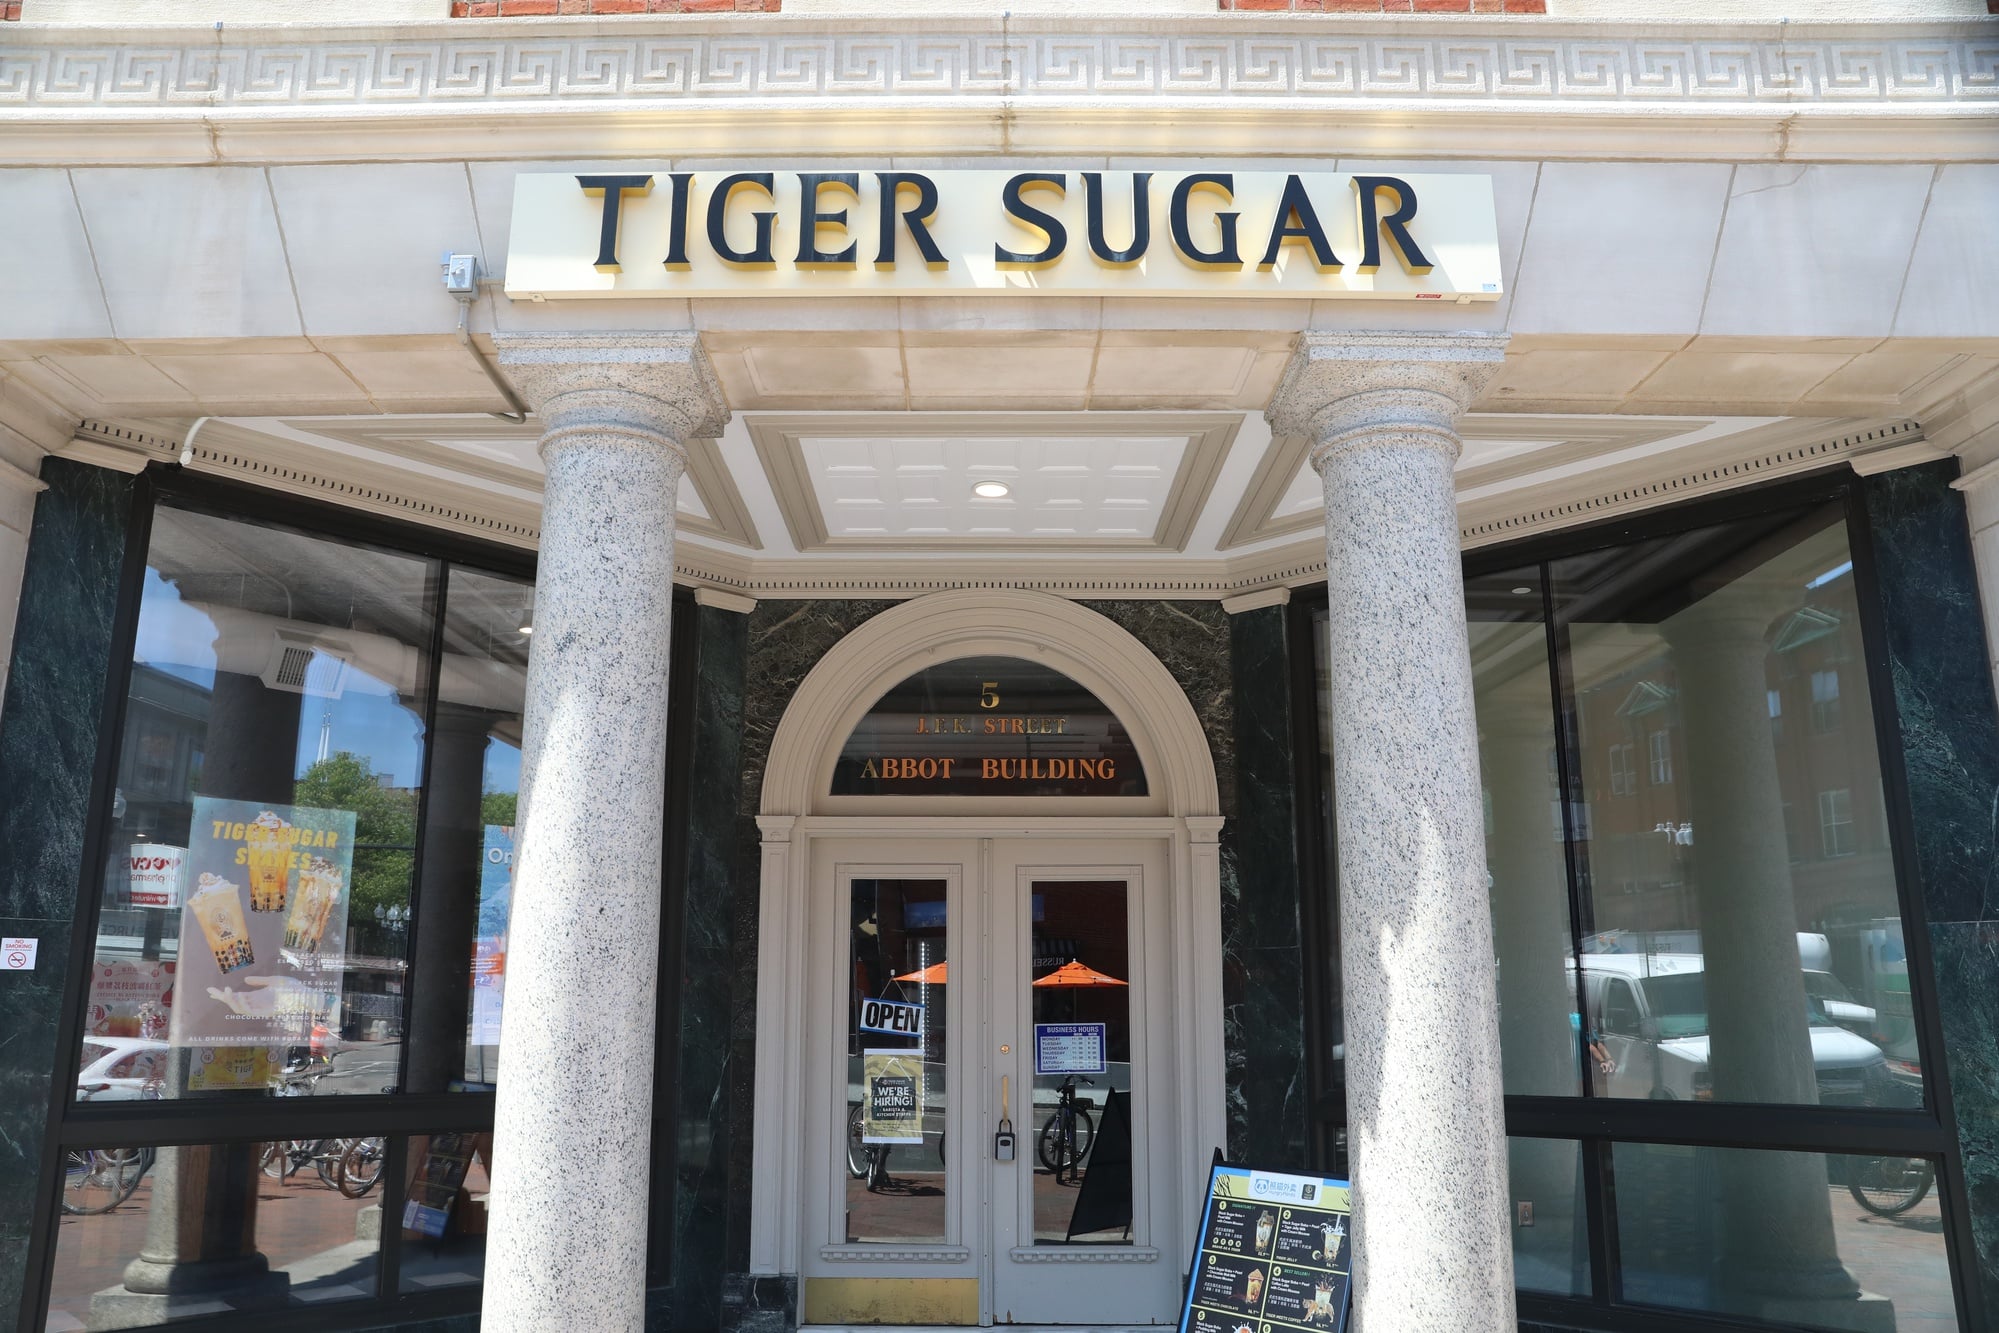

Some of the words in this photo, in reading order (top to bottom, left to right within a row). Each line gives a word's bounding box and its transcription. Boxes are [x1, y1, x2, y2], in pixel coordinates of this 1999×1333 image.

[575, 173, 950, 273] TIGER
[995, 172, 1435, 274] SUGAR
[980, 682, 1000, 708] 5
[983, 718, 1067, 734] STREET
[860, 757, 956, 779] ABBOT
[981, 757, 1116, 780] BUILDING
[212, 820, 270, 843] TIGER
[276, 826, 339, 849] SUGAR
[234, 847, 313, 870] SHAKES
[865, 1002, 921, 1033] OPEN
[874, 1096, 913, 1106] HIRING!
[878, 1086, 910, 1096] WE'RE
